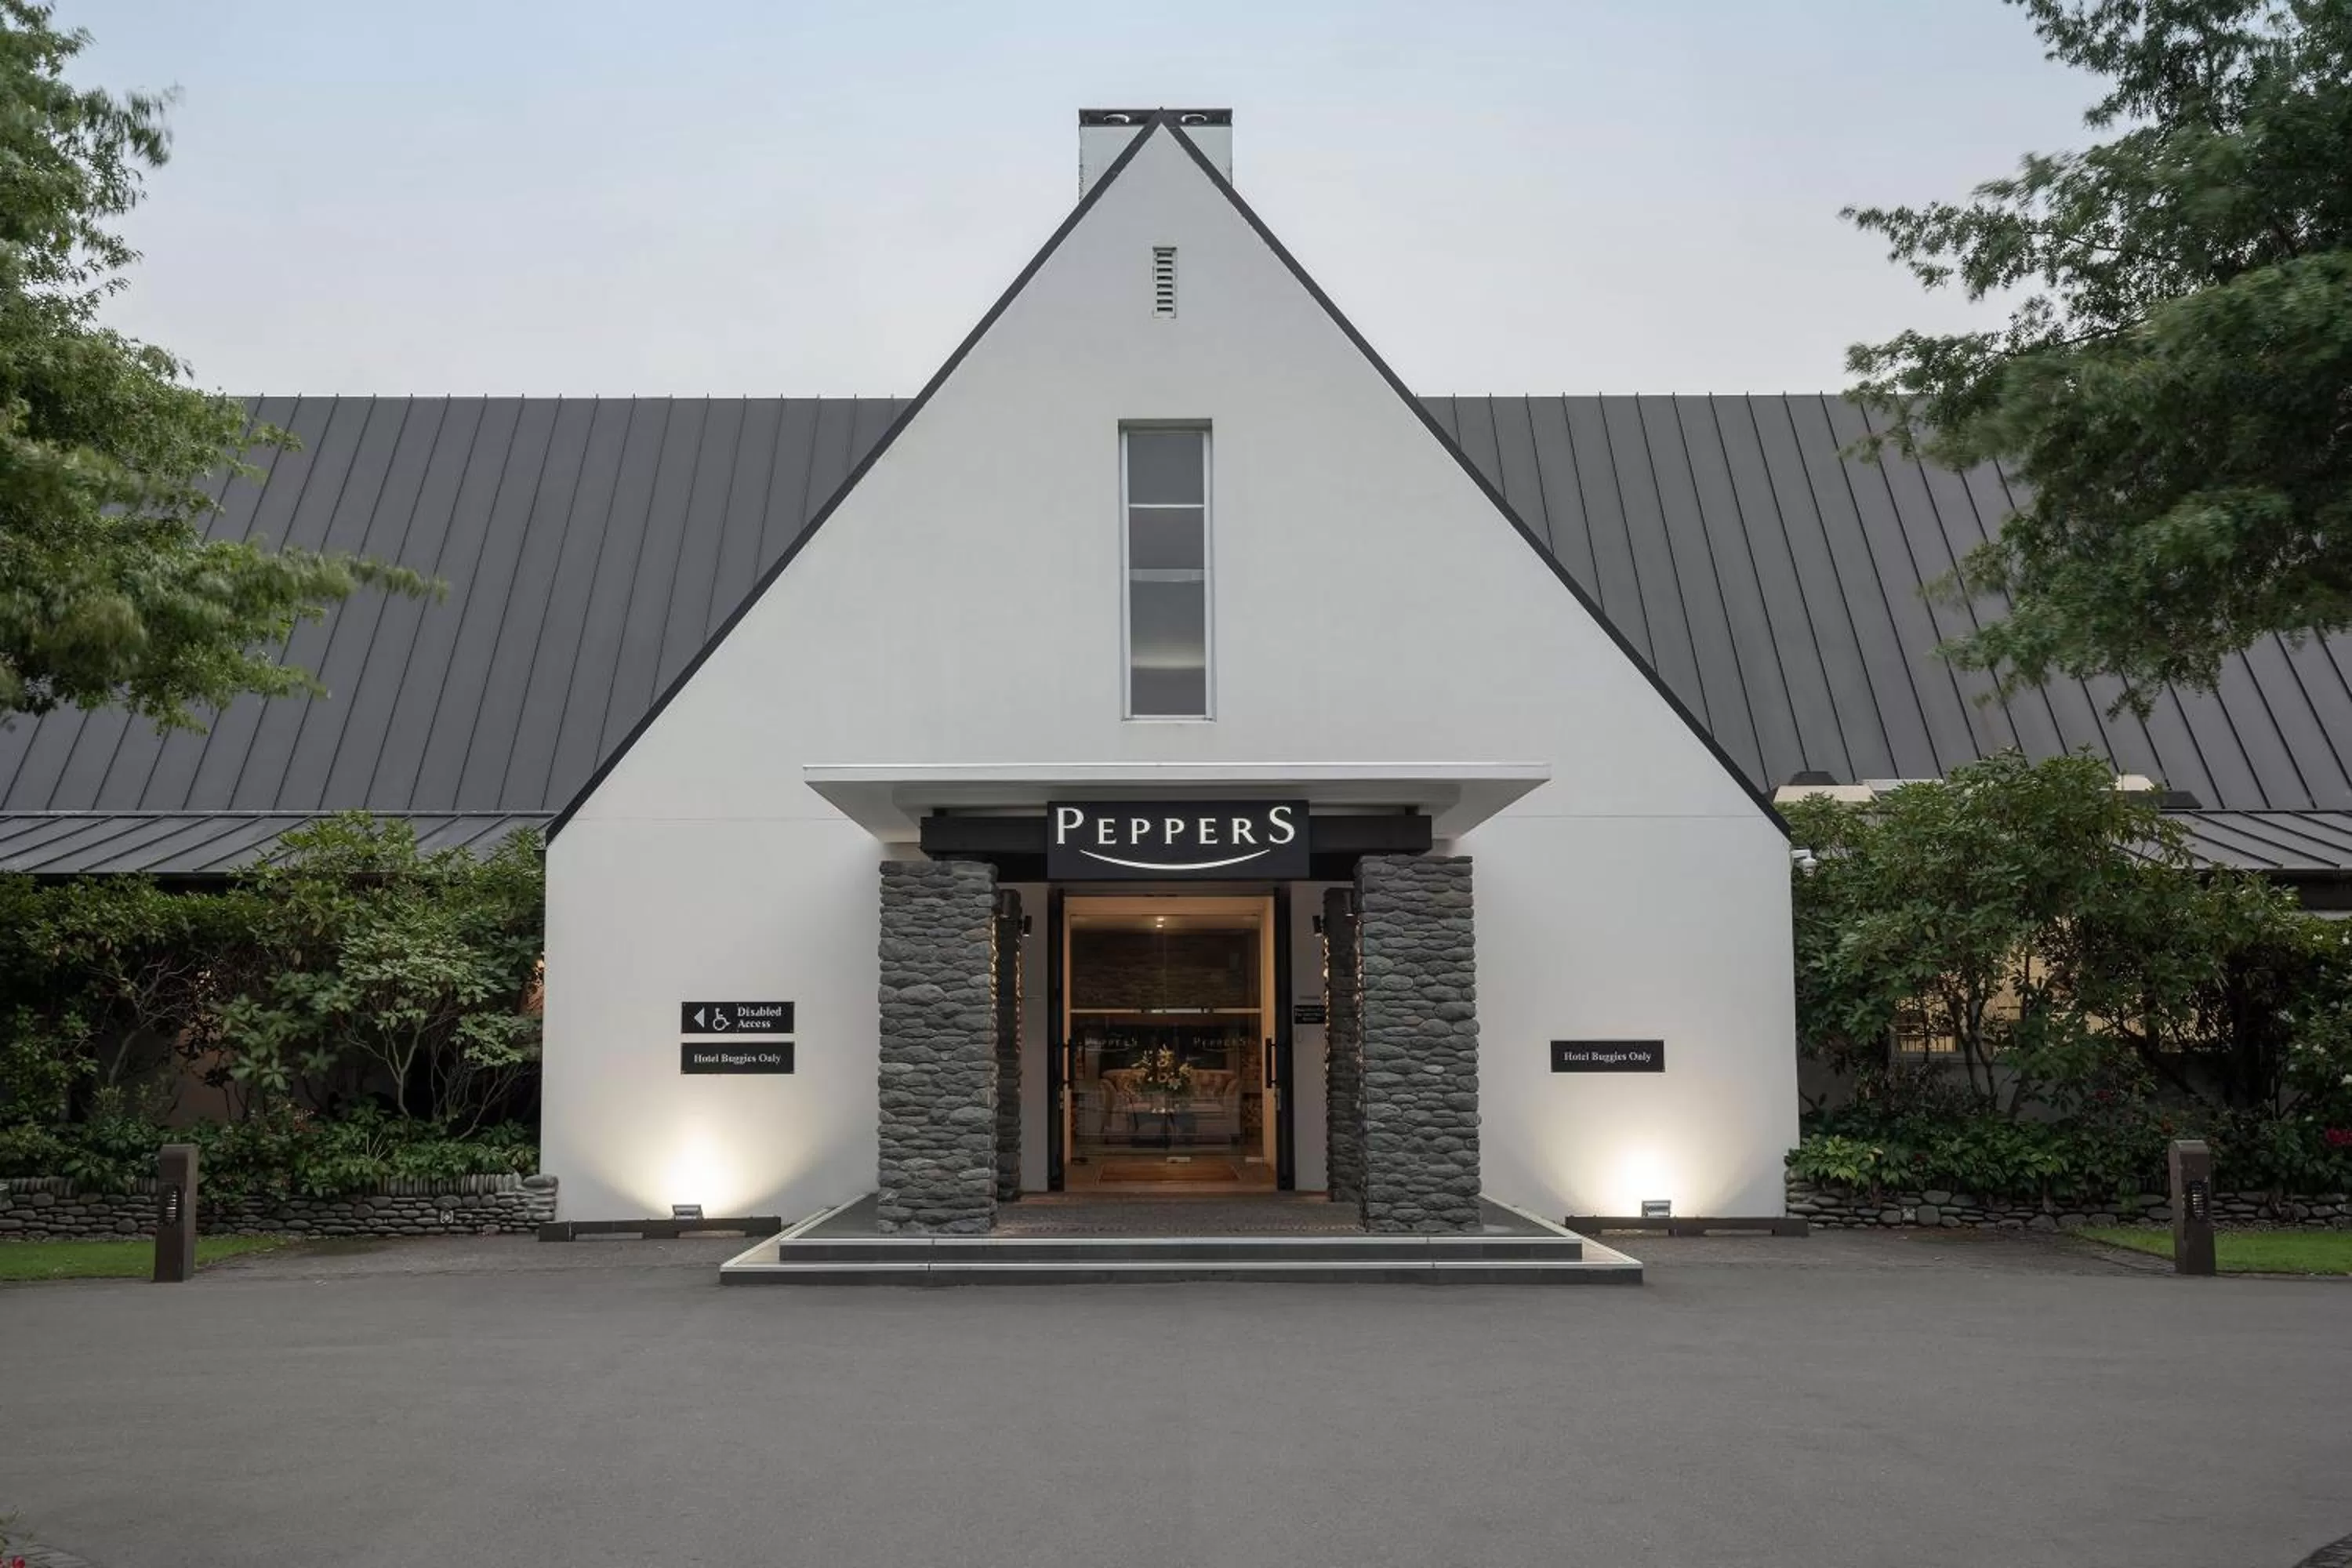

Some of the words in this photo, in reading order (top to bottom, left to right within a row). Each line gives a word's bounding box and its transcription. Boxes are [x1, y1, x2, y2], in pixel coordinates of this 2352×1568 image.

[1055, 805, 1297, 845] PEPPERS
[737, 1006, 782, 1017] Disabled
[738, 1019, 771, 1028] Access
[694, 1053, 719, 1063] Hotel
[721, 1053, 757, 1065] Buggies
[758, 1053, 782, 1065] Only
[1563, 1051, 1589, 1062] Hotel
[1592, 1051, 1627, 1063] Buggies
[1628, 1051, 1652, 1063] Only
